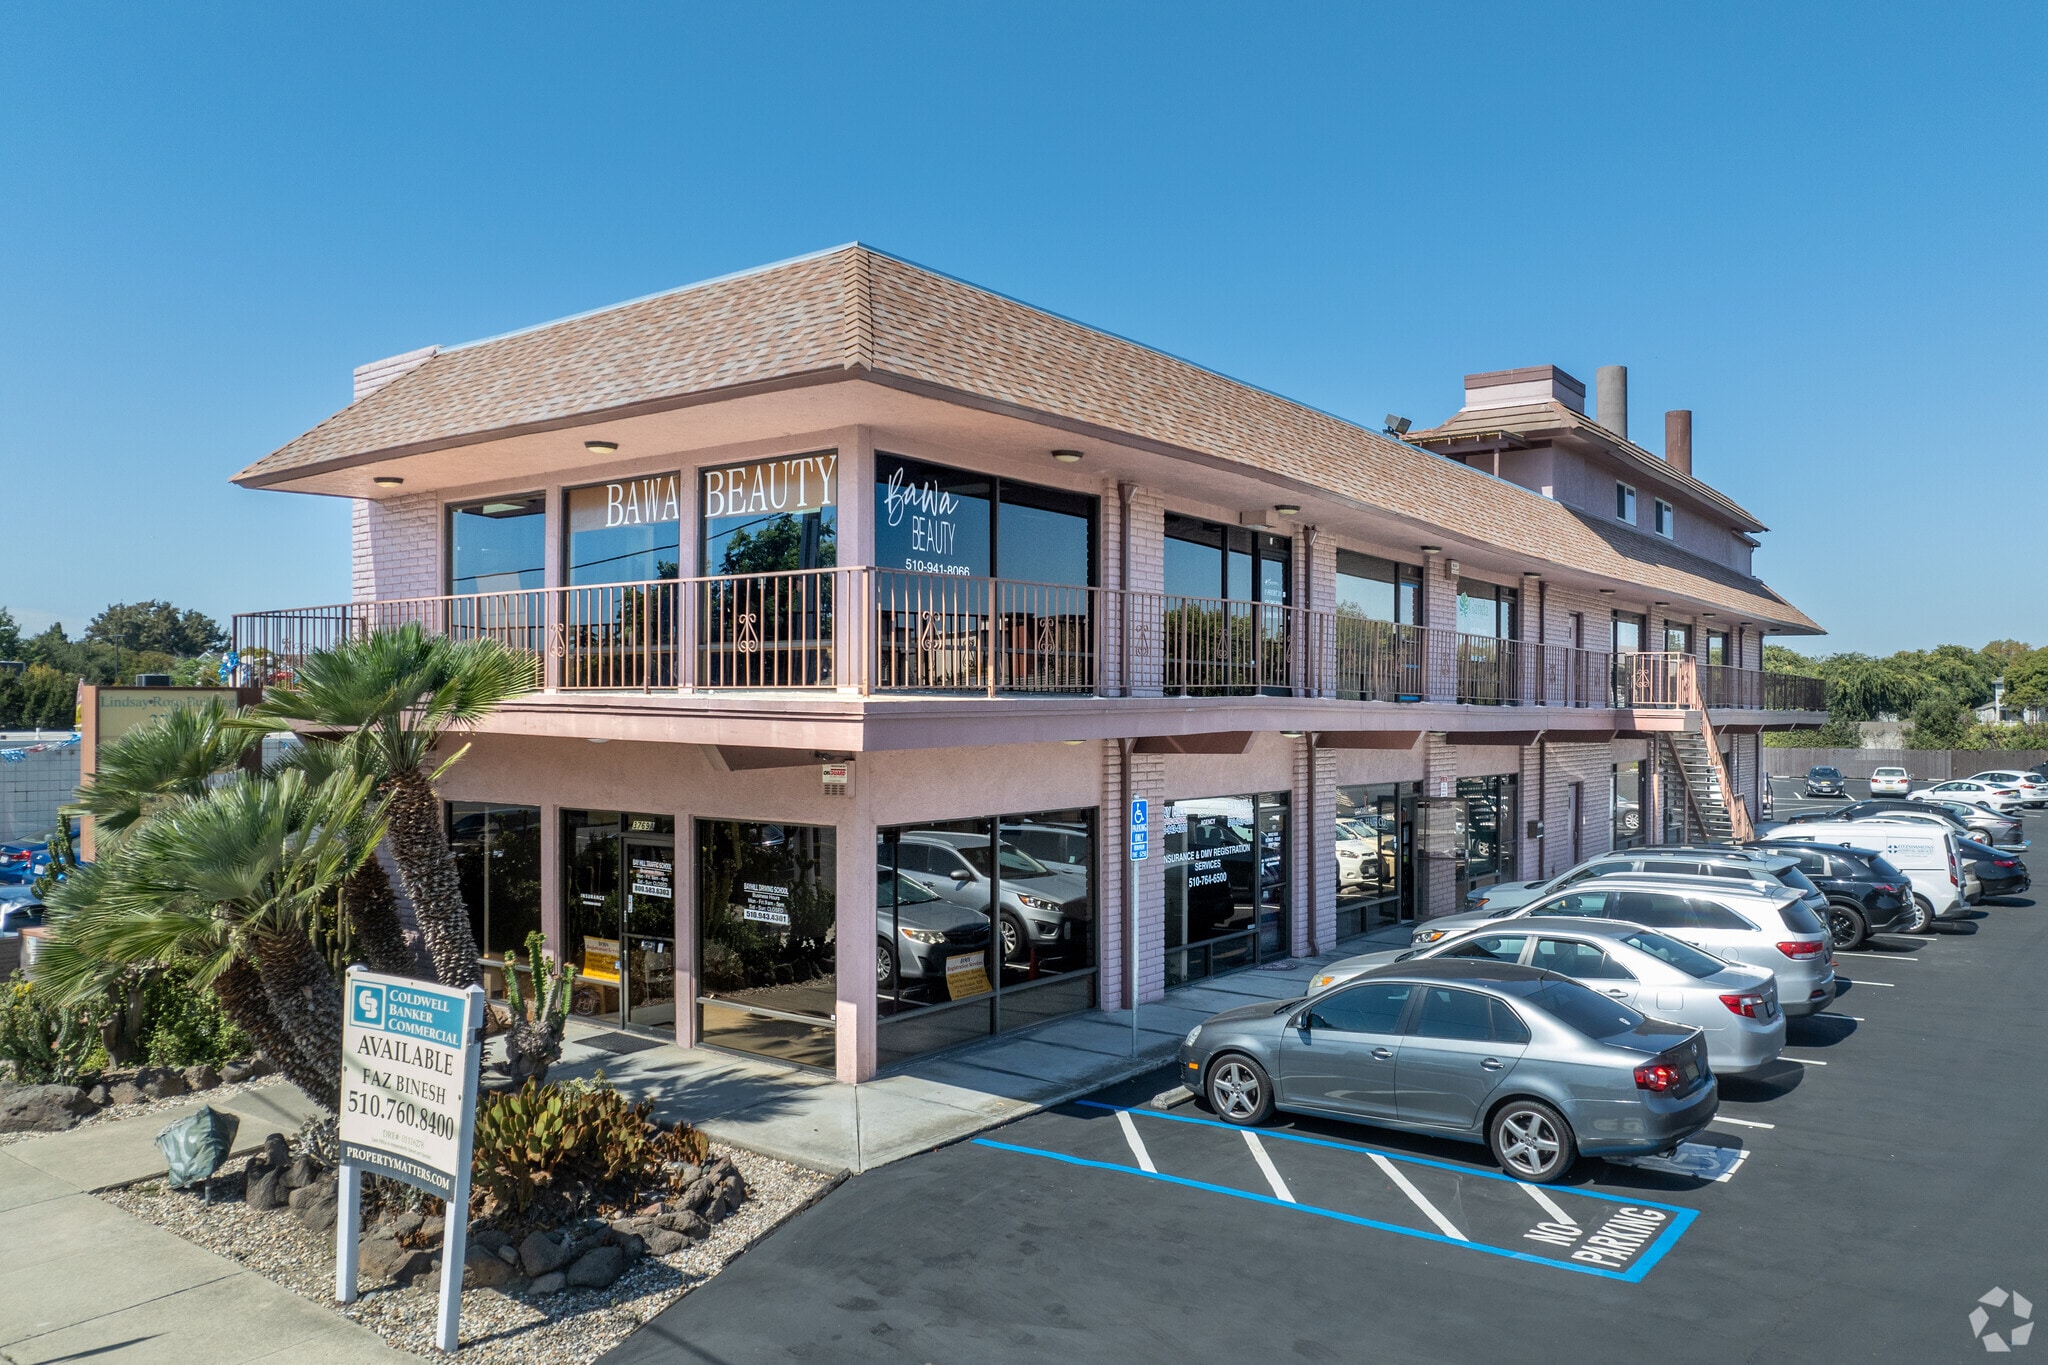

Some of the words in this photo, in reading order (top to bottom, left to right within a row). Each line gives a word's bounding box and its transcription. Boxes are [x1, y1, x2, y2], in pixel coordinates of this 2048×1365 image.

[605, 475, 680, 528] BAWA
[704, 454, 837, 518] BEAUTY
[912, 515, 956, 556] BEAUTY
[905, 558, 970, 577] 510-941-8066
[100, 695, 149, 710] Lindsay
[1164, 851, 1195, 864] NSURANCE
[1195, 850, 1199, 859] &
[1200, 849, 1213, 858] DMV
[1213, 844, 1251, 857] REGISTRATION
[1194, 859, 1221, 871] SERVICES
[774, 886, 789, 895] SCHOOL
[1188, 872, 1227, 888] 510-764-6500
[580, 893, 605, 901] INSURANCE
[389, 989, 450, 1013] COLDWELL
[389, 1003, 433, 1024] BANKER
[388, 1018, 459, 1046] COMMERCIAL
[357, 1034, 454, 1076] AVAILABLE
[362, 1068, 391, 1090] FAZ
[396, 1076, 446, 1105] BINESH
[347, 1090, 454, 1141] 510.760.8400
[346, 1146, 450, 1191] PROPERTYMATTERS.COM
[1523, 1221, 1584, 1247] NO
[1571, 1207, 1667, 1268] PARKING
